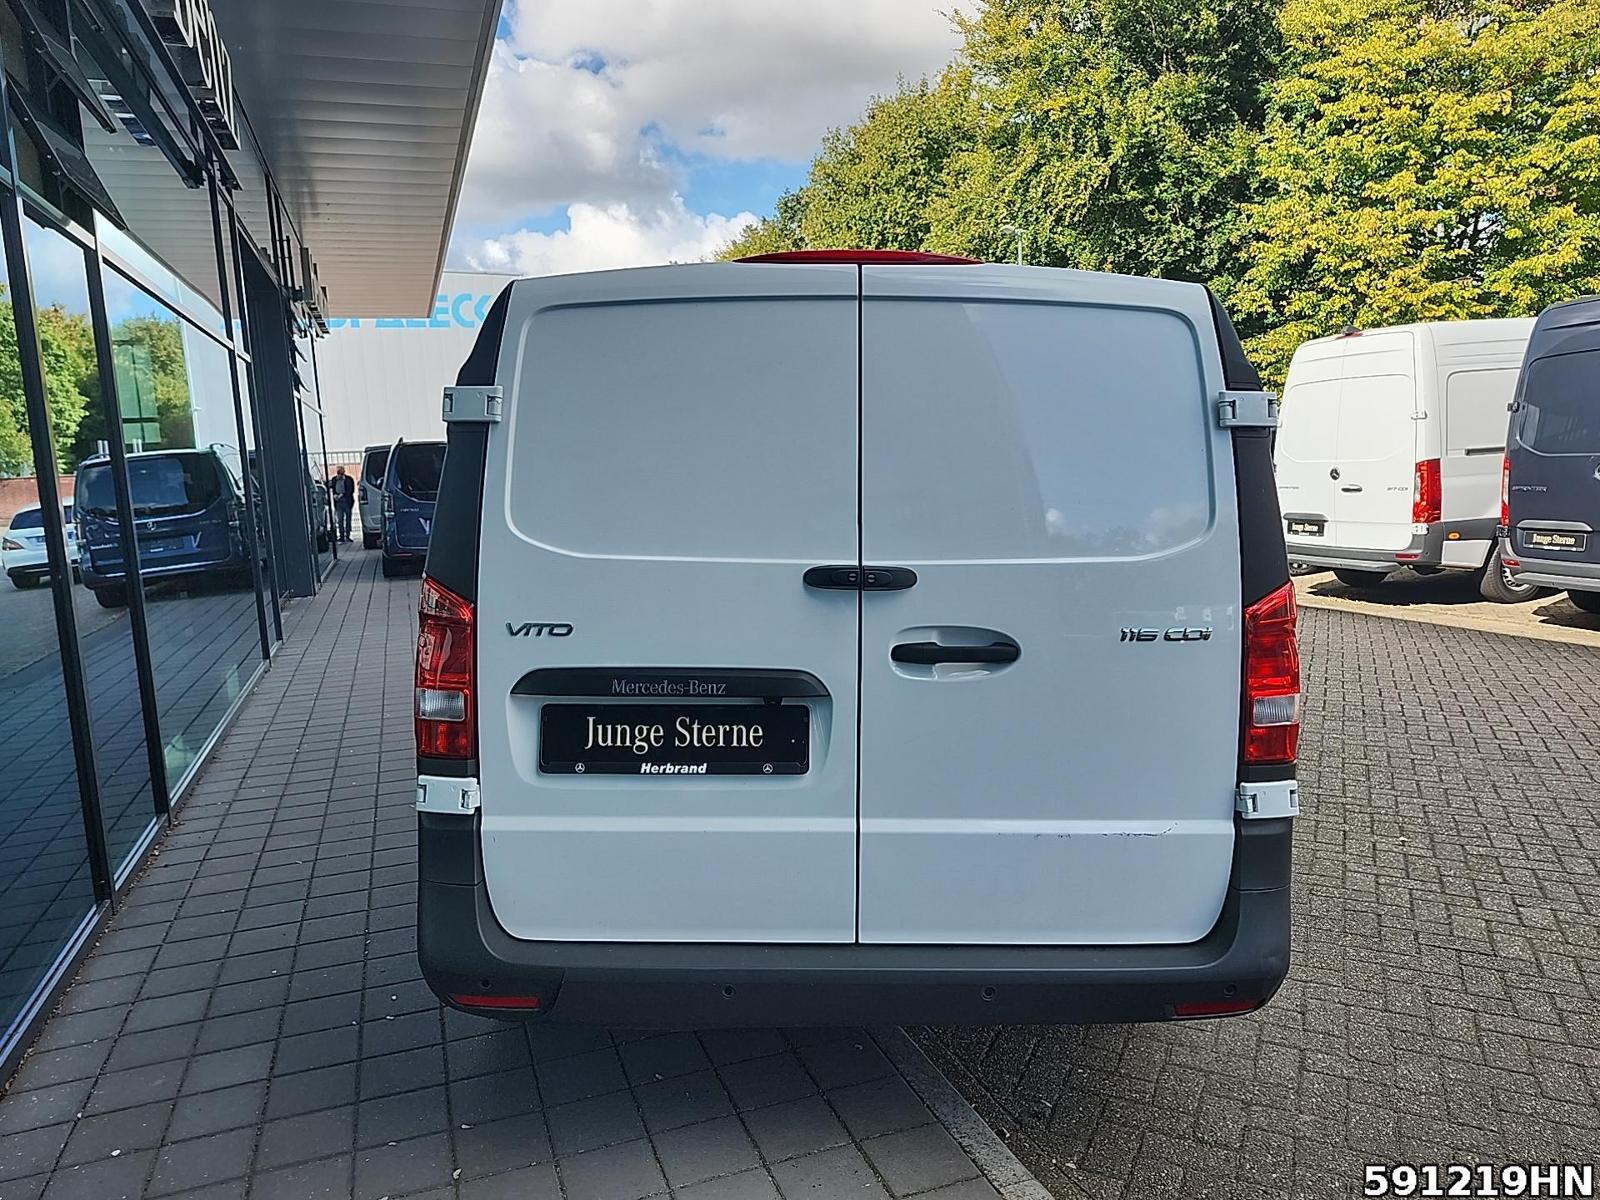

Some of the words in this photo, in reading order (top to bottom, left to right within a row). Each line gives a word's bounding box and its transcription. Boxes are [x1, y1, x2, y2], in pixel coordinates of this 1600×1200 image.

[1532, 533, 1552, 545] Junge
[1552, 534, 1576, 545] Sterne
[505, 622, 574, 638] VITO
[1119, 626, 1159, 643] 116
[611, 679, 727, 697] Mercedes-Benz
[584, 715, 664, 755] Junge
[674, 715, 764, 748] Sterne
[639, 761, 708, 775] Herbrand
